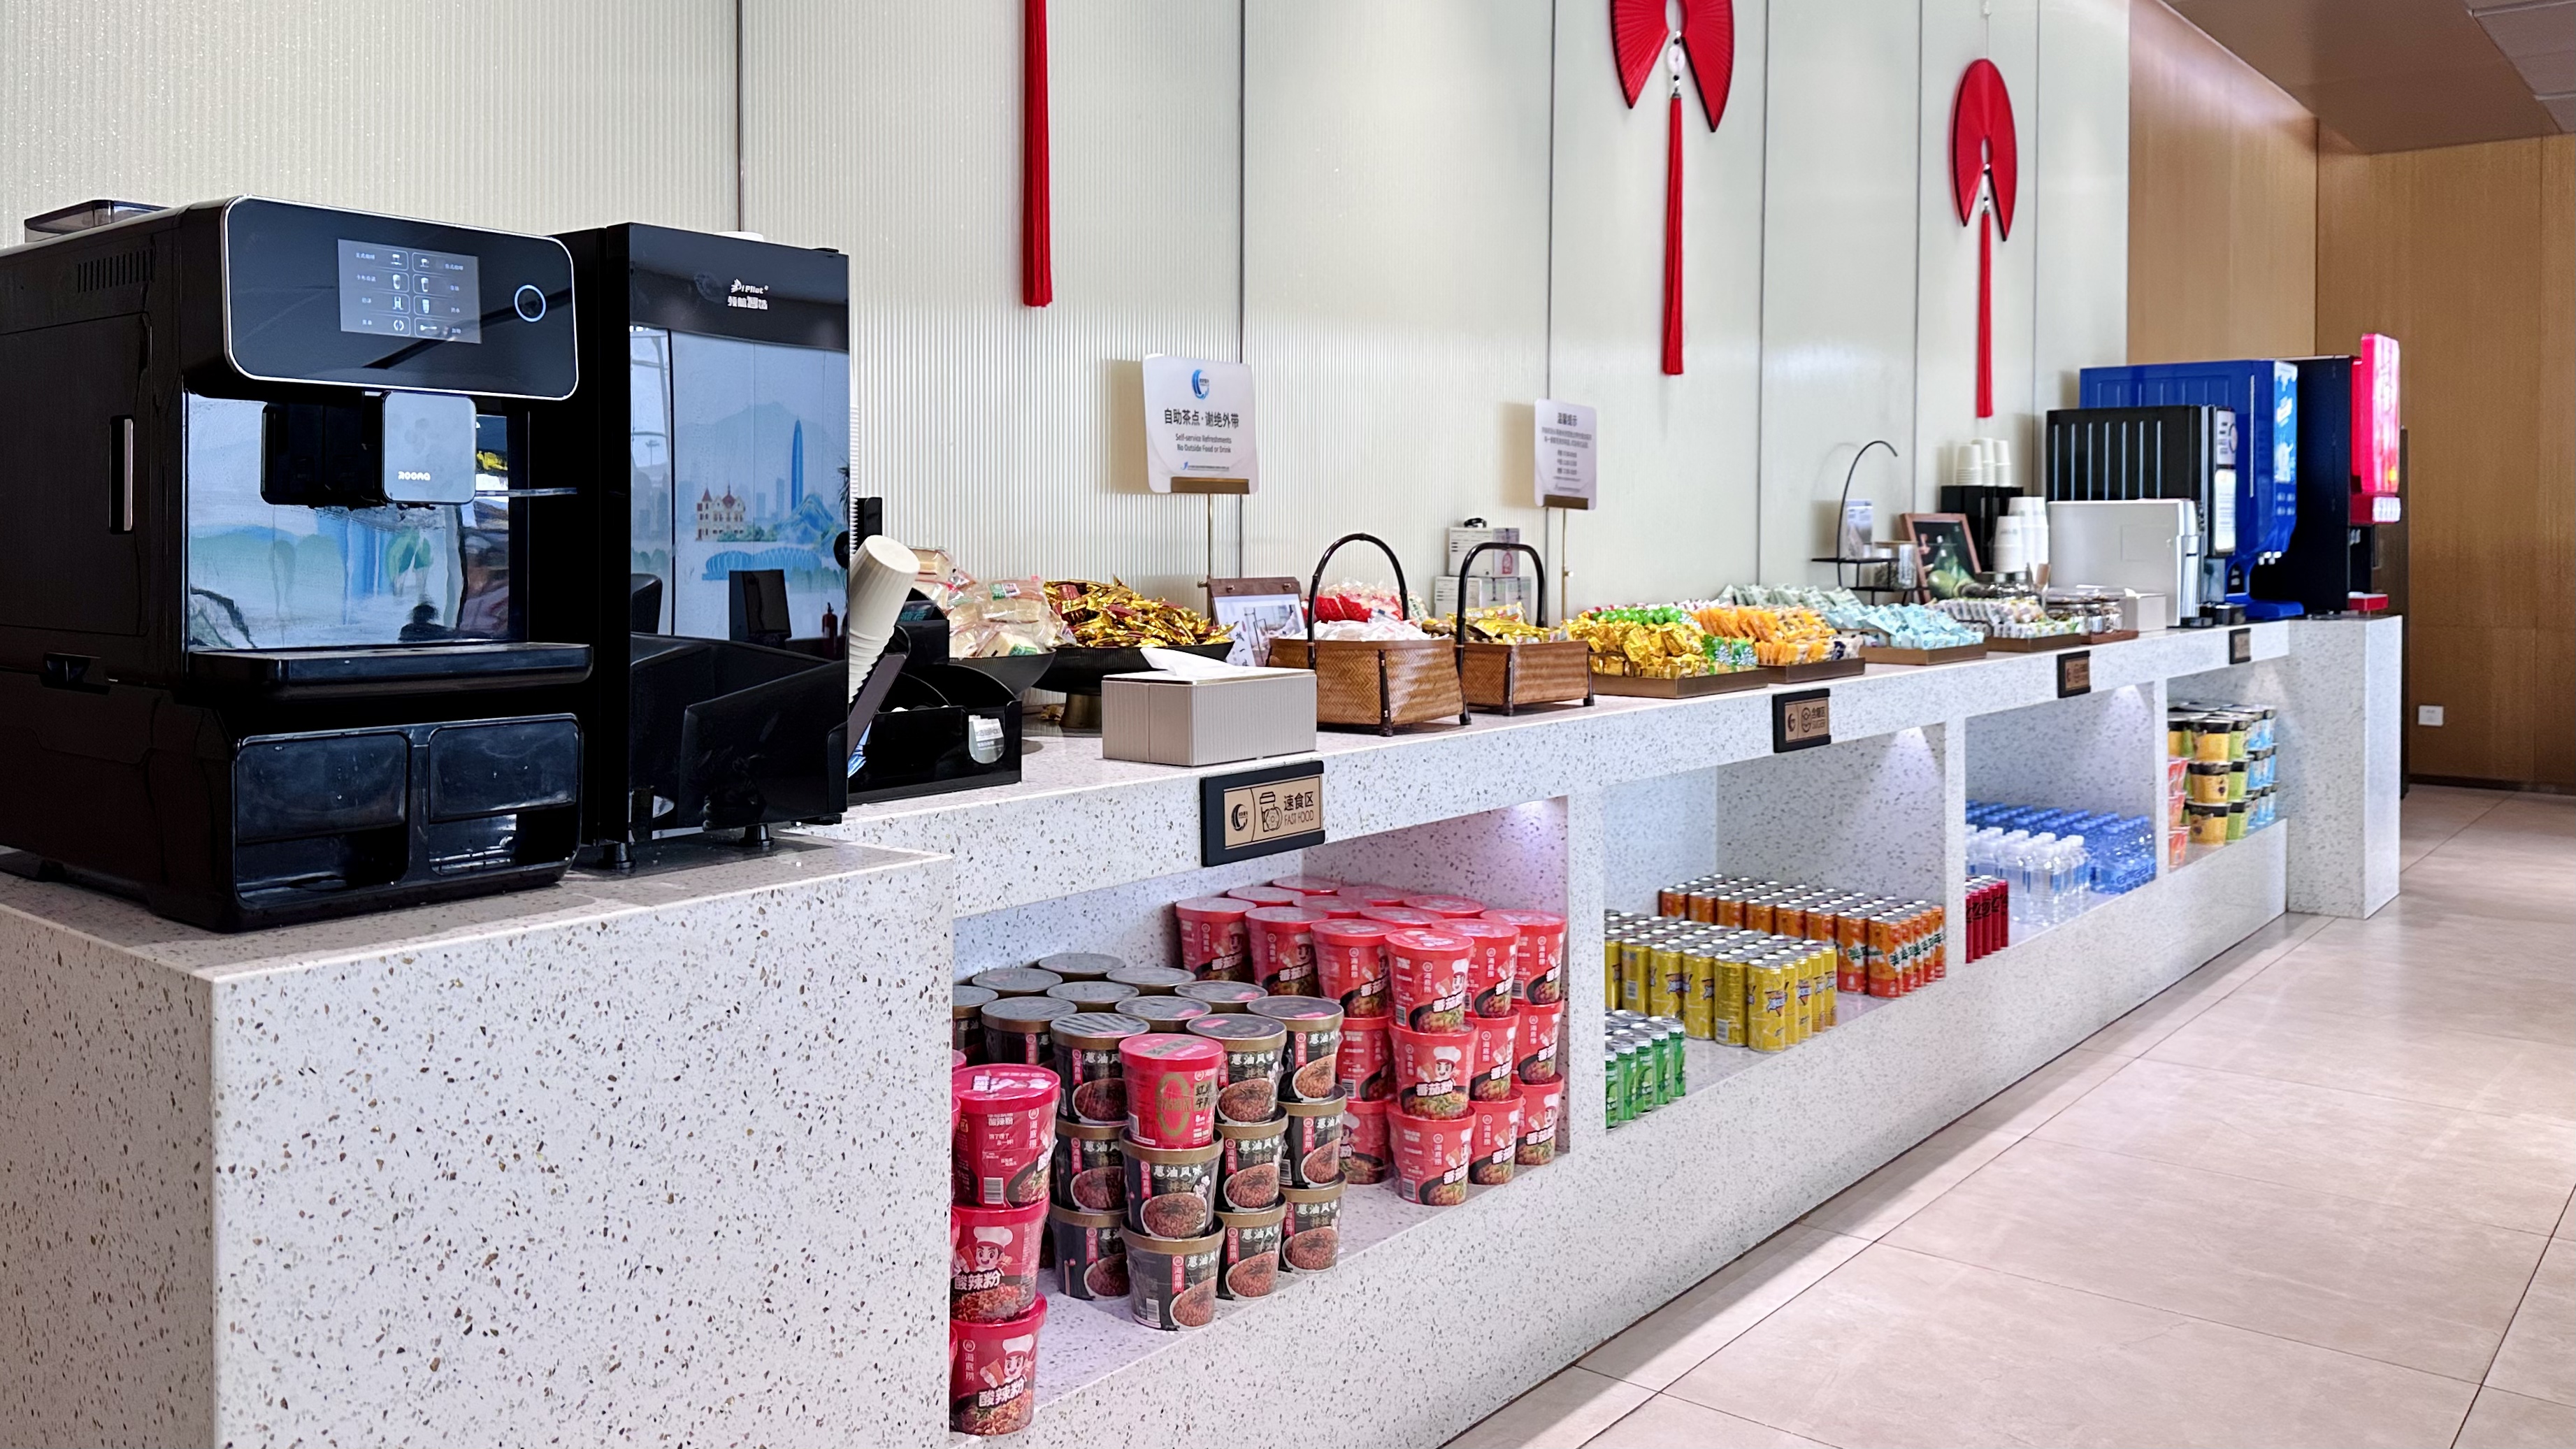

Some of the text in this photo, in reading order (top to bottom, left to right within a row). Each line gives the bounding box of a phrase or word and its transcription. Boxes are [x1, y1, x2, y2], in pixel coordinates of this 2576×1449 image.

[1164, 408, 1239, 428] 自助茶点·谢绝外带
[1283, 791, 1314, 812] 速食区
[1284, 809, 1314, 826] FAST FOOD
[1416, 1079, 1453, 1096] 番茄粉
[1154, 1164, 1204, 1178] 葱油风味
[1297, 1199, 1338, 1215] 葱油风味
[954, 1269, 1001, 1291] 酸辣粉
[979, 1379, 1026, 1408] 酸辣粉
